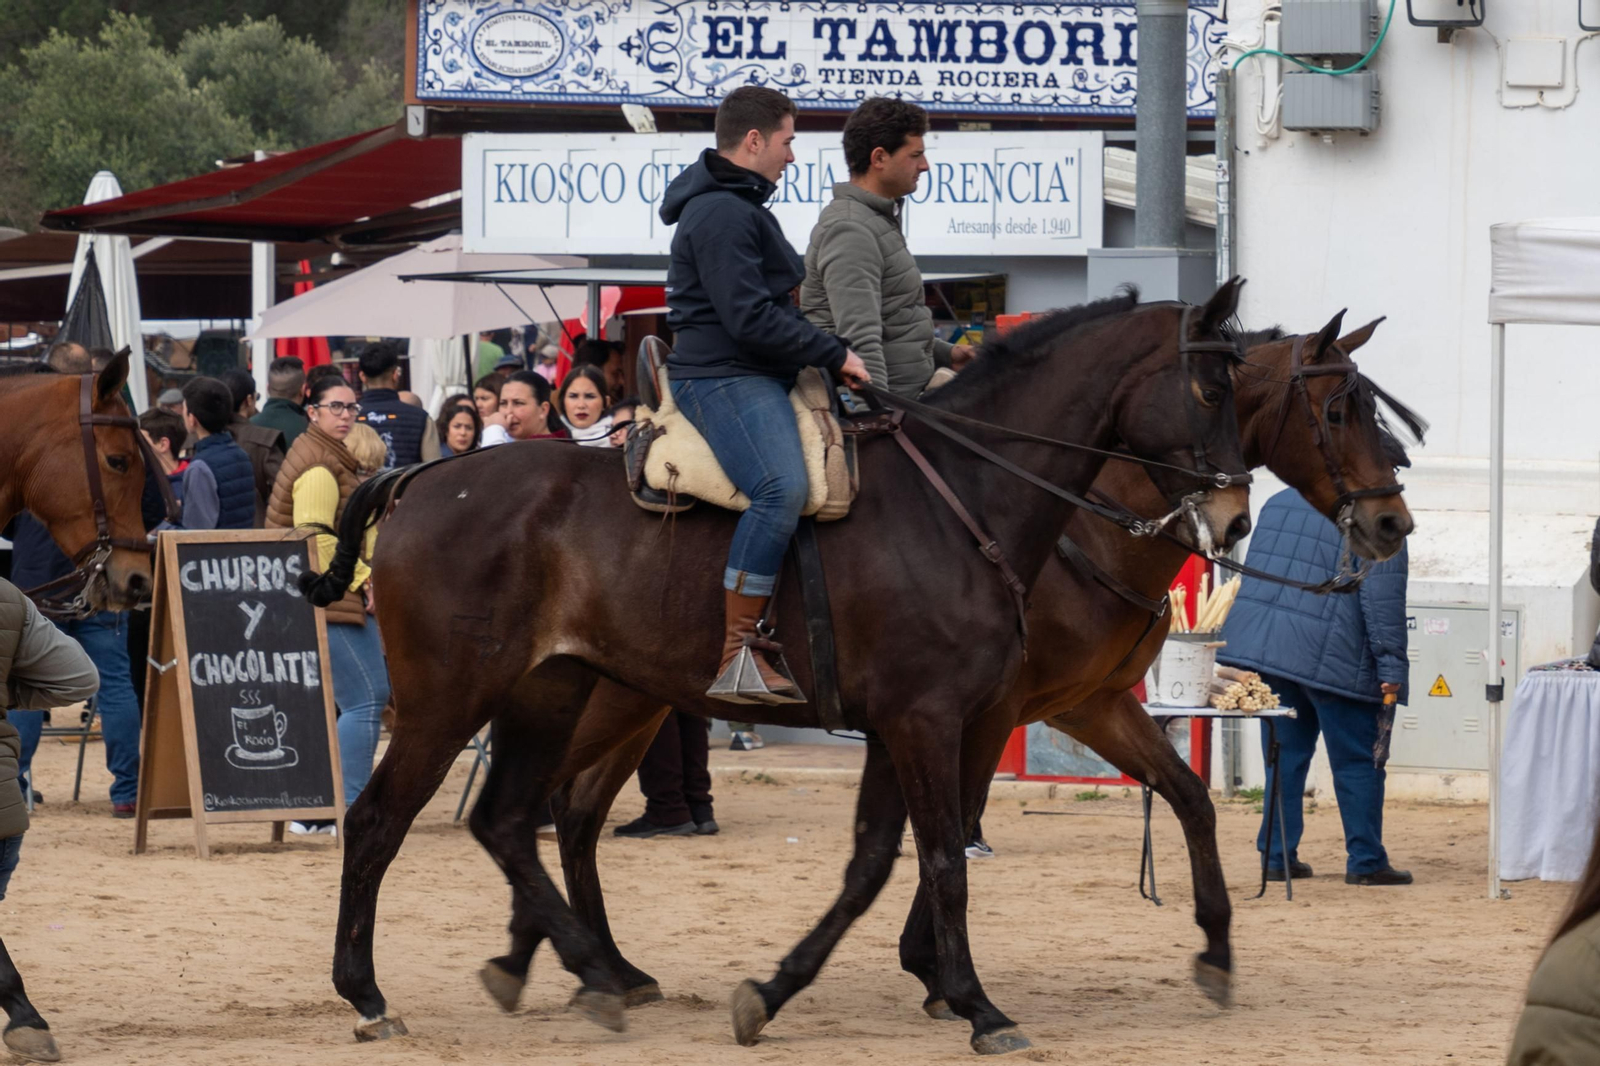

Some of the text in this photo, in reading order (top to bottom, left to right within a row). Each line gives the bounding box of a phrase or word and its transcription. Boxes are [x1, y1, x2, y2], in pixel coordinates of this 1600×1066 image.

[500, 40, 551, 48] TAMBORIL
[702, 15, 1138, 67] EL TAMBORI
[818, 68, 1060, 89] TIENDA ROCIERA
[494, 162, 626, 203] KIOSCO
[947, 216, 1072, 235] Artesanos desde 1.940
[180, 554, 304, 597] CHURROS
[238, 600, 267, 640] Y
[190, 649, 320, 687] CHOCOLATE
